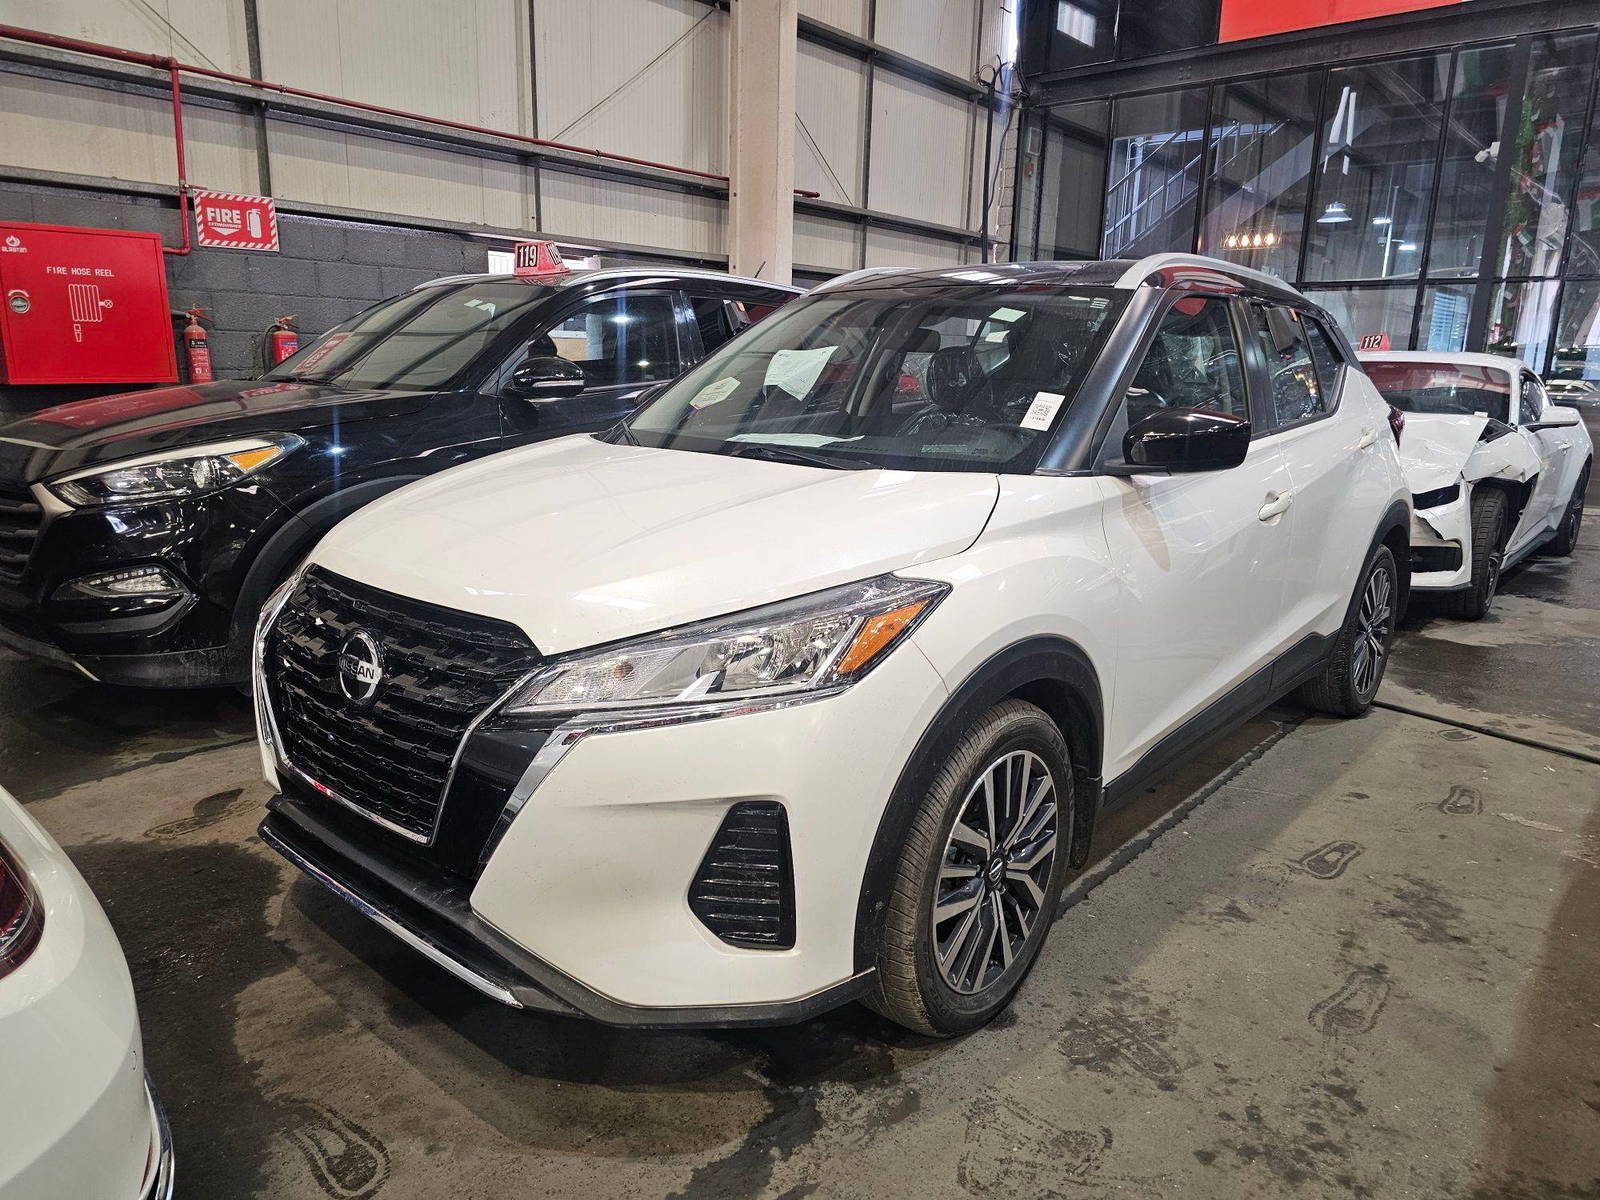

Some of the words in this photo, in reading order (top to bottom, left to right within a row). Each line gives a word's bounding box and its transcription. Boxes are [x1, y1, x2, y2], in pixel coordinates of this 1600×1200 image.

[206, 207, 242, 224] FIRE
[519, 245, 538, 267] 119
[46, 266, 68, 275] FIRE
[71, 267, 92, 276] HOSE
[95, 268, 115, 277] REEL
[1363, 335, 1382, 349] 112
